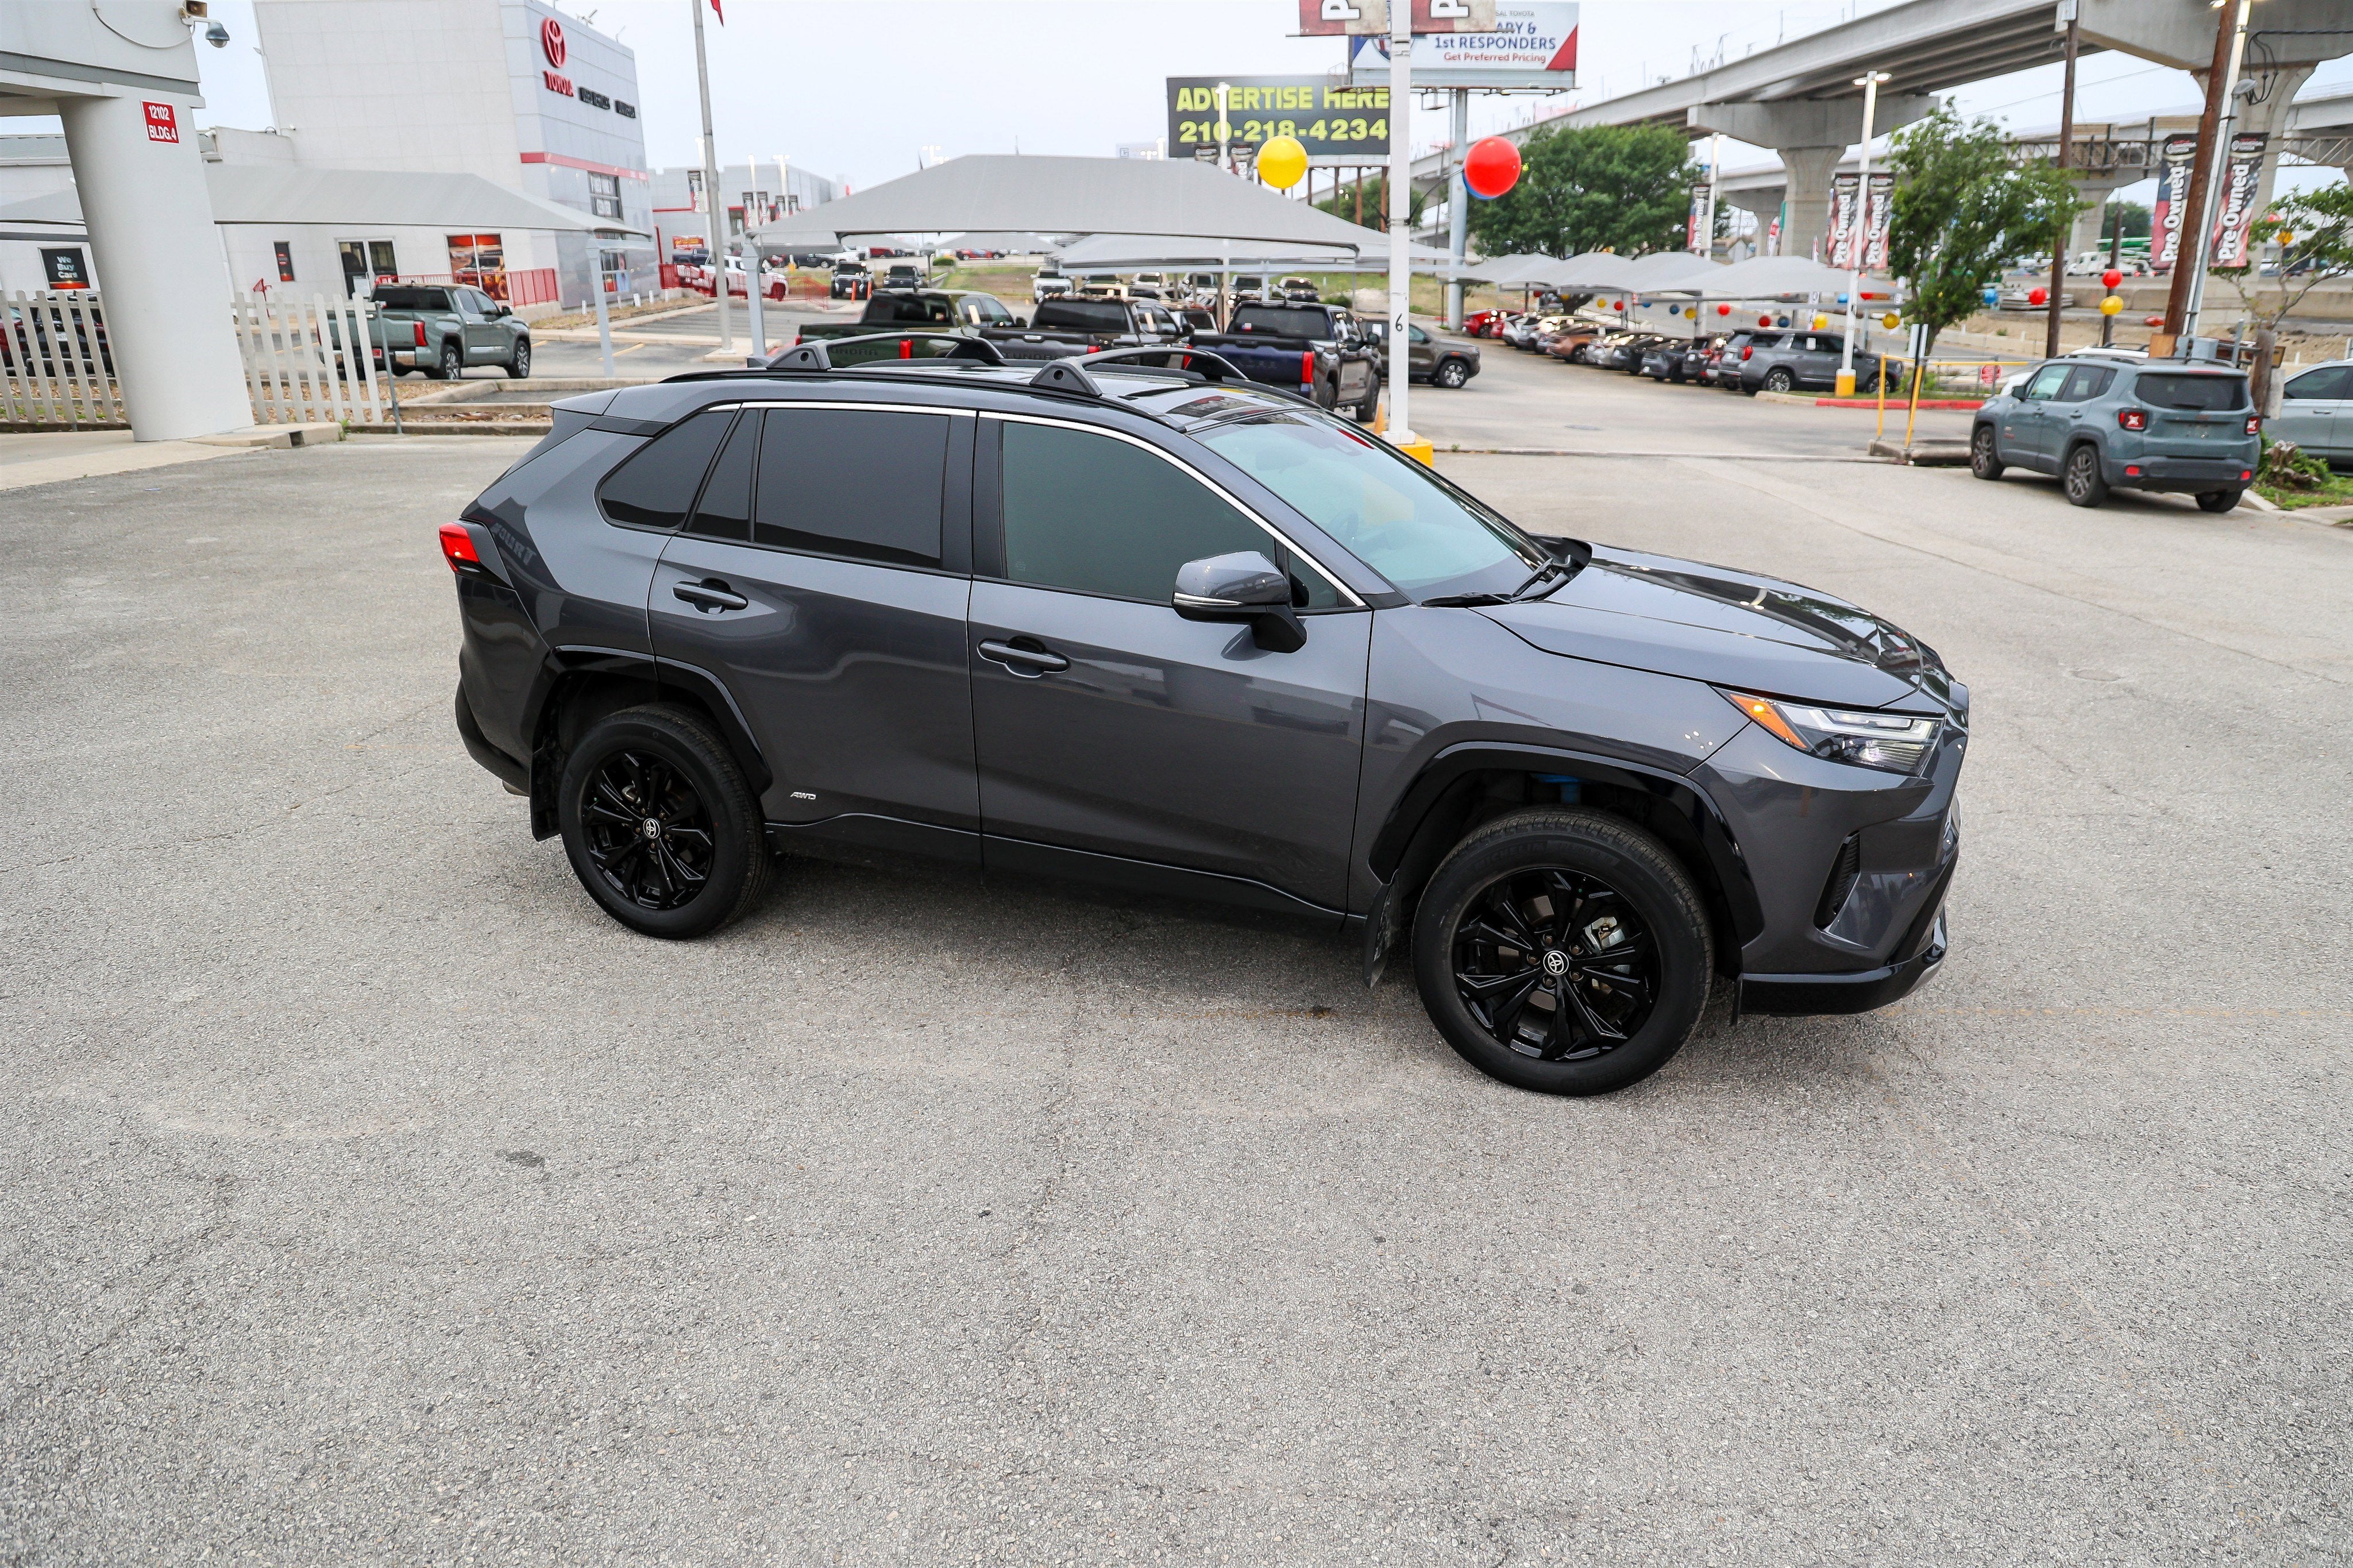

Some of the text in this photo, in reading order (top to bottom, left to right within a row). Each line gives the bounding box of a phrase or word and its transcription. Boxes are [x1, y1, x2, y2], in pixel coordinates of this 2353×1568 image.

[1435, 36, 1556, 49] 1st RESPONDERS
[1444, 52, 1546, 63] Get Preferred Pricing
[543, 69, 574, 97] TOYOTA
[1323, 86, 1390, 110] HERE
[148, 105, 171, 121] 12102
[171, 127, 177, 141] 4
[1179, 118, 1388, 144] 210-218-4234
[2163, 165, 2186, 229] Owned
[1835, 194, 1851, 241] Owned
[1868, 194, 1885, 241] Owned
[2217, 164, 2250, 260] Pre Owned
[1832, 241, 1847, 264] Pre
[1865, 241, 1880, 264] Pre
[2159, 230, 2179, 262] Pre
[1395, 313, 1403, 331] 6
[790, 791, 816, 800] AWD
